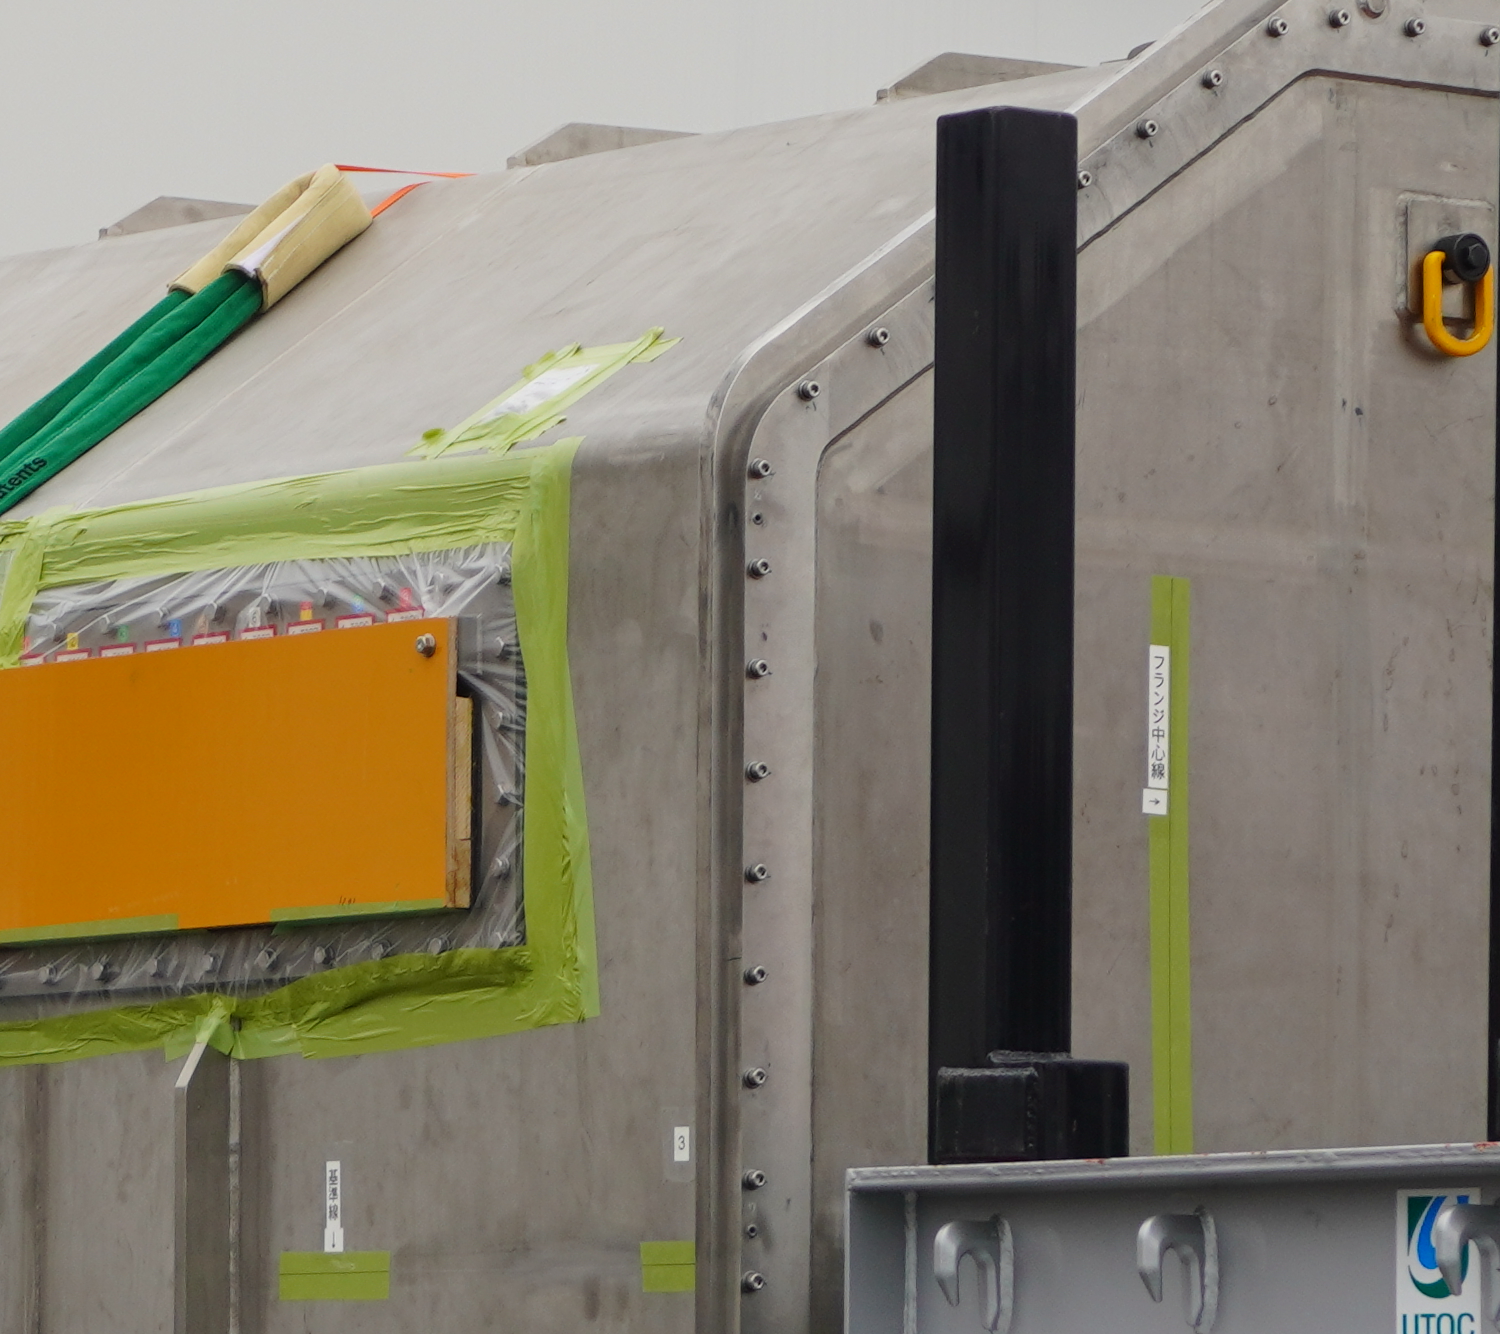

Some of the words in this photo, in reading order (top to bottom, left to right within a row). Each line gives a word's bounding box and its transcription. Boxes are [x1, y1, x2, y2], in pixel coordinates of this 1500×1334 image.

[1151, 655, 1166, 780] フランジ中心線
[678, 1135, 686, 1151] 3
[329, 1169, 339, 1221] 基準線
